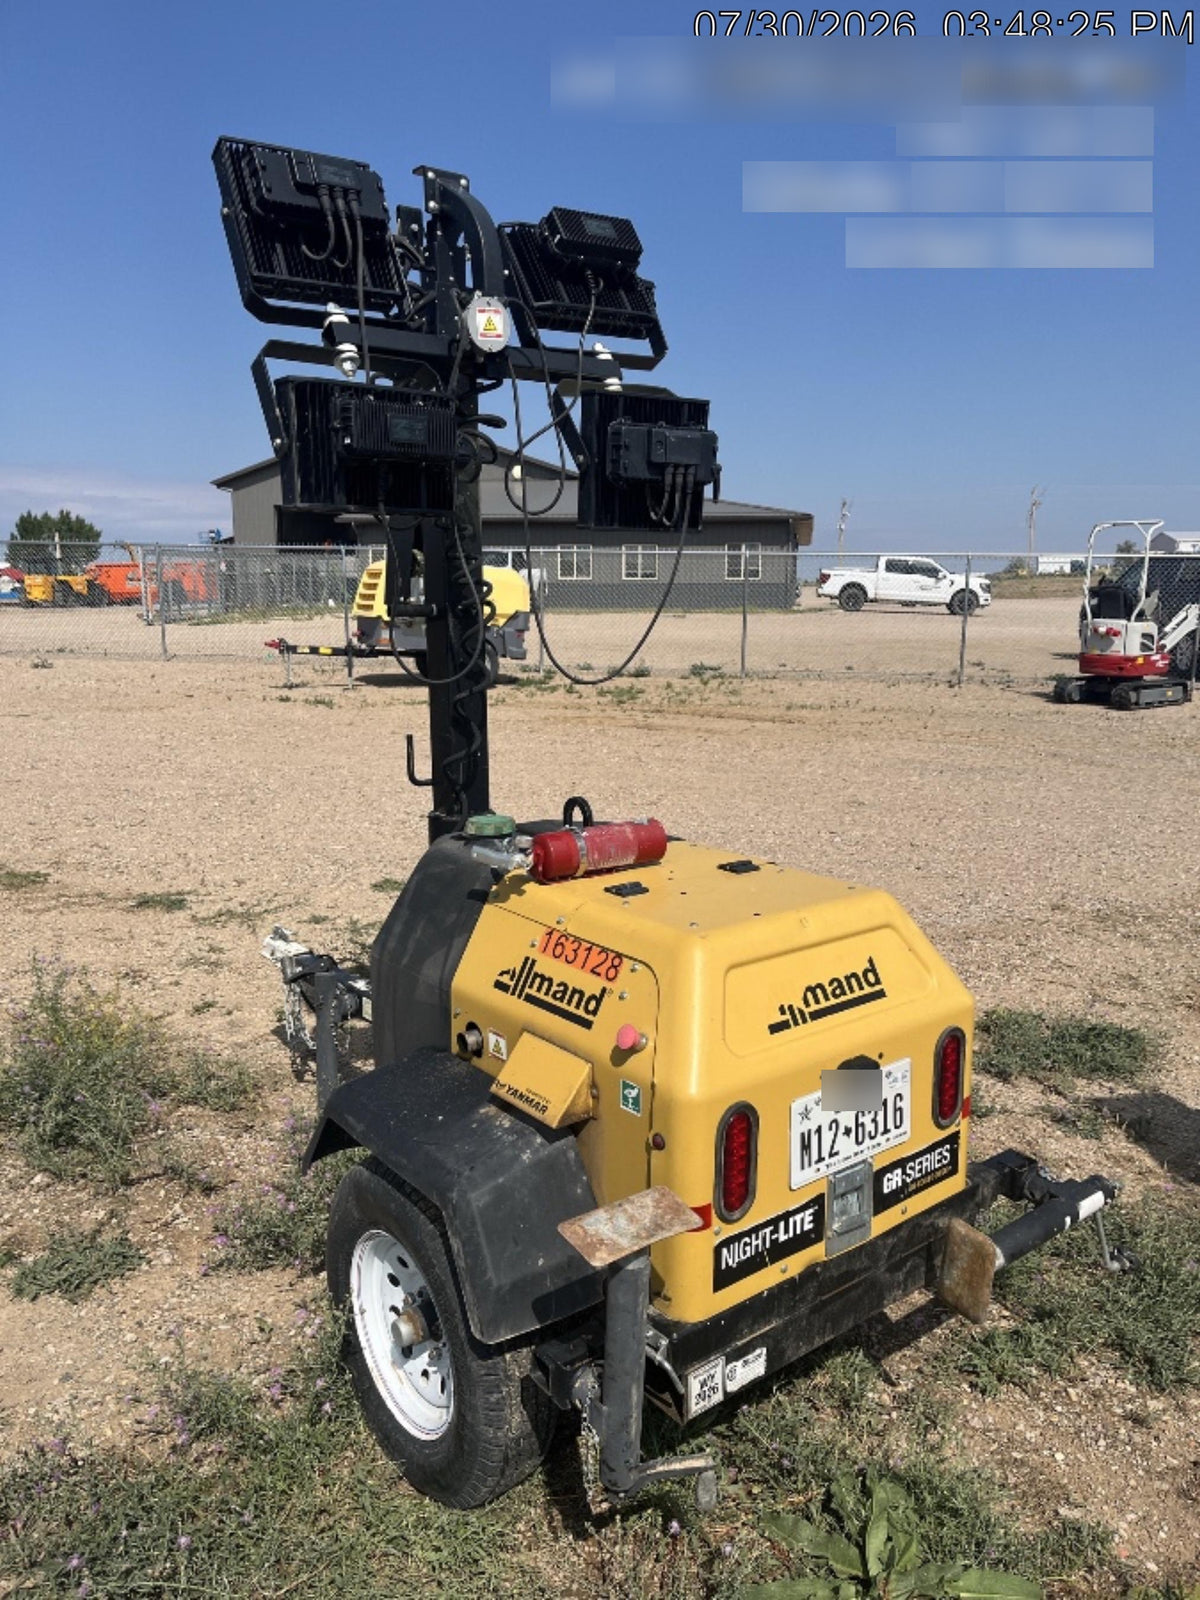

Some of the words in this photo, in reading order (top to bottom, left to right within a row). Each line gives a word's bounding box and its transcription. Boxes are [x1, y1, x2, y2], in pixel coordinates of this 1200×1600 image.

[541, 928, 623, 983] 163128
[506, 1084, 549, 1115] YANMAR
[720, 1206, 816, 1271] NIGHT-LITE
